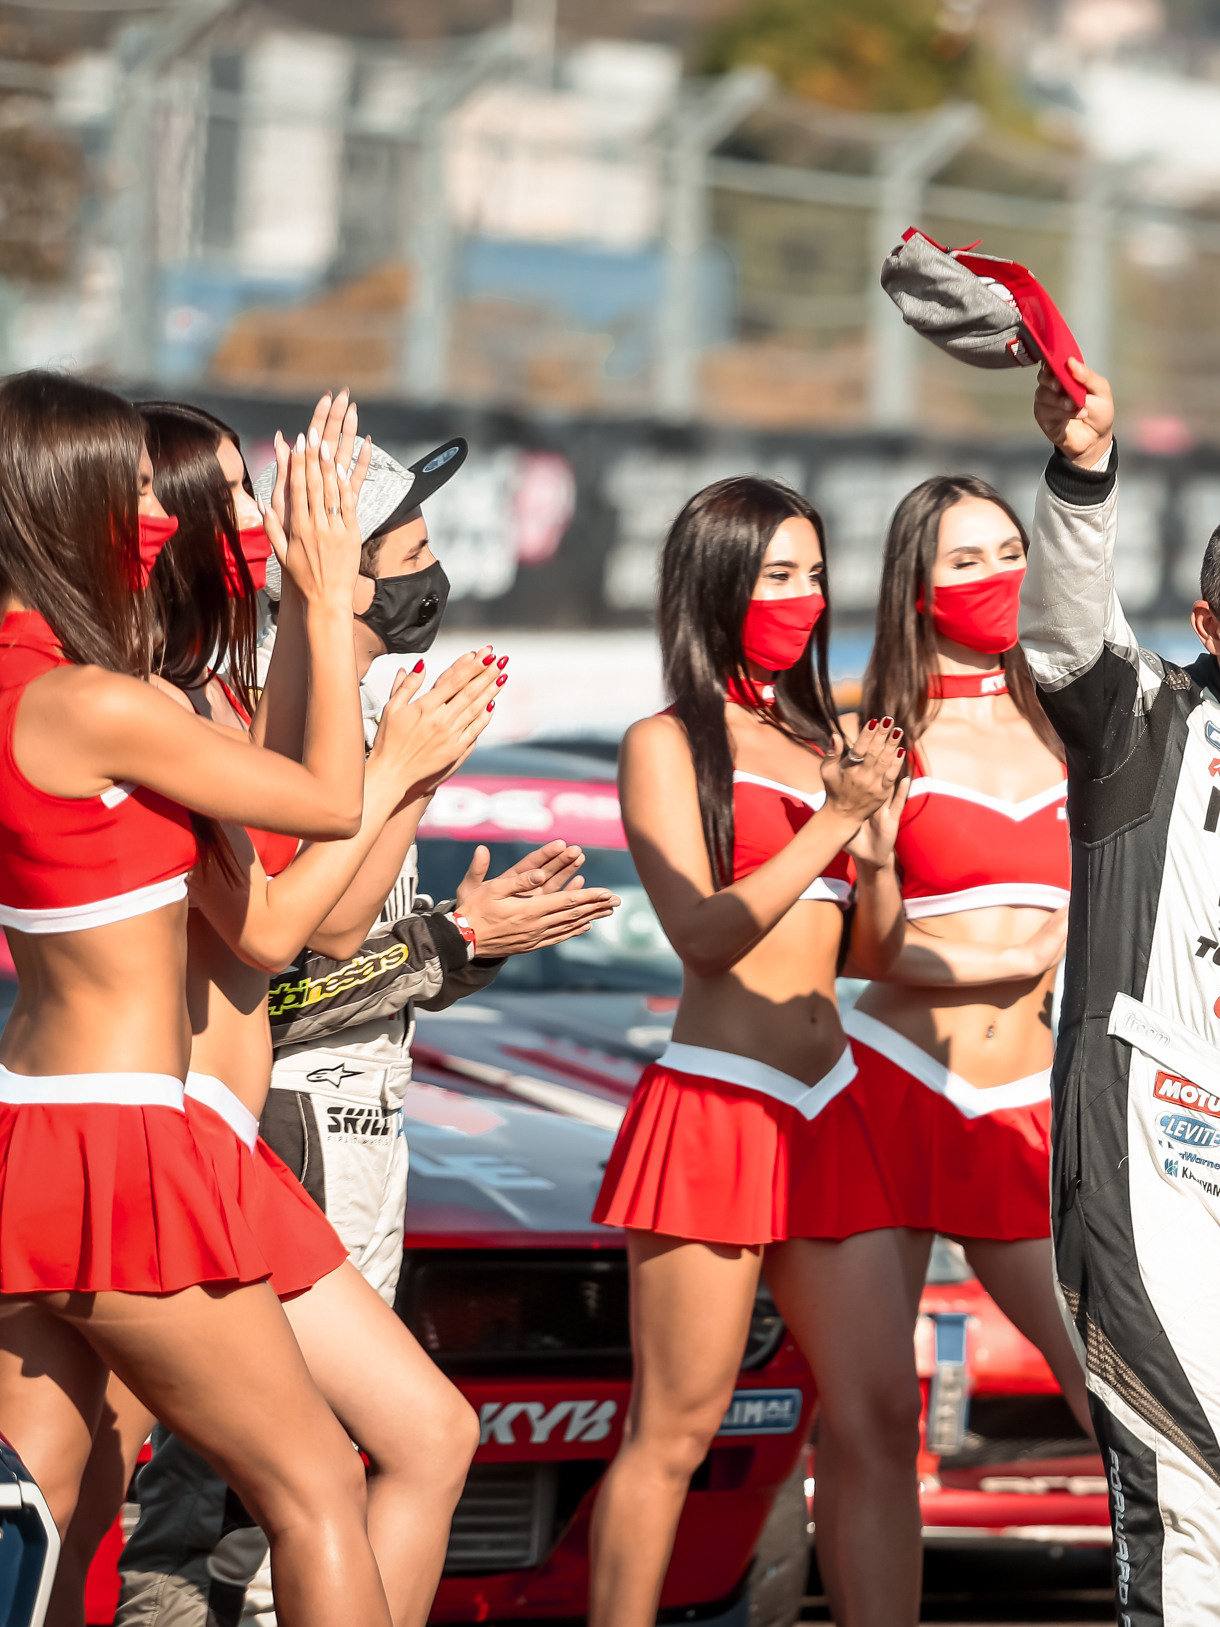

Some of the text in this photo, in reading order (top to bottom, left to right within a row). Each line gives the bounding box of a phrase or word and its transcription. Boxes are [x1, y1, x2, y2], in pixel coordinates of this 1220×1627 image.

[327, 1107, 390, 1136] SKILL
[480, 1400, 617, 1445] KYB
[1108, 1446, 1132, 1606] FORWARD
